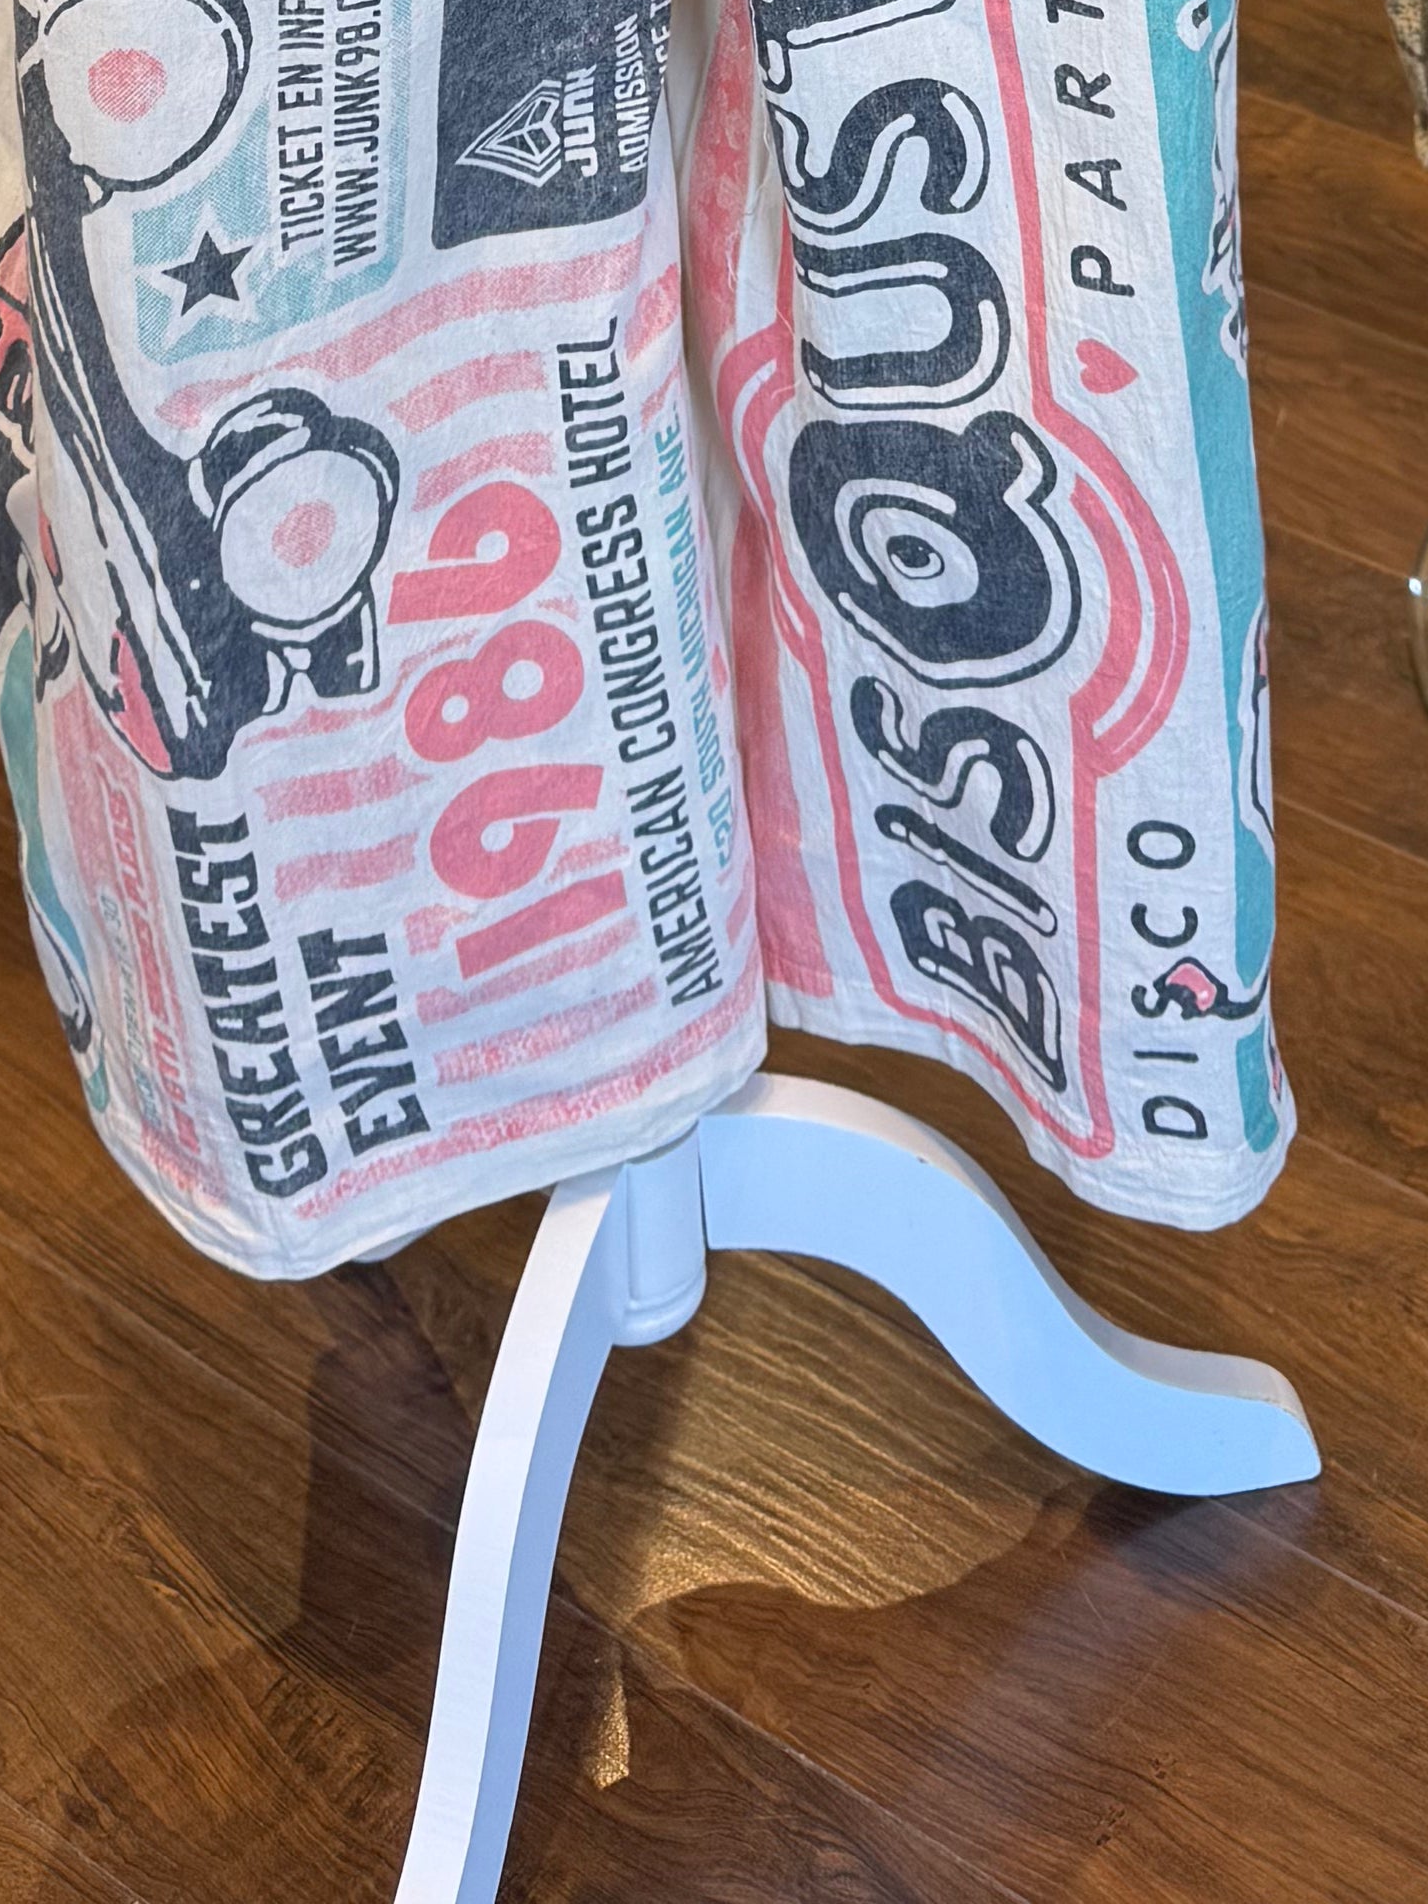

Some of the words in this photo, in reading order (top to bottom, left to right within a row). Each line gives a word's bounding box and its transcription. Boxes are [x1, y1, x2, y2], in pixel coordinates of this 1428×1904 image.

[277, 64, 324, 111] EN
[563, 63, 599, 178] JUNK
[613, 12, 651, 175] ADMISSION
[277, 125, 325, 252] TICKET
[557, 314, 633, 492] HOTEL
[576, 492, 679, 765] CONGRESS
[662, 513, 706, 687] MICHIGAN
[386, 479, 629, 981] 1986
[689, 686, 726, 798] SOUTH
[624, 765, 725, 1009] AMERICAN
[166, 803, 330, 1198] GREATEST
[298, 926, 431, 1160] EVENT
